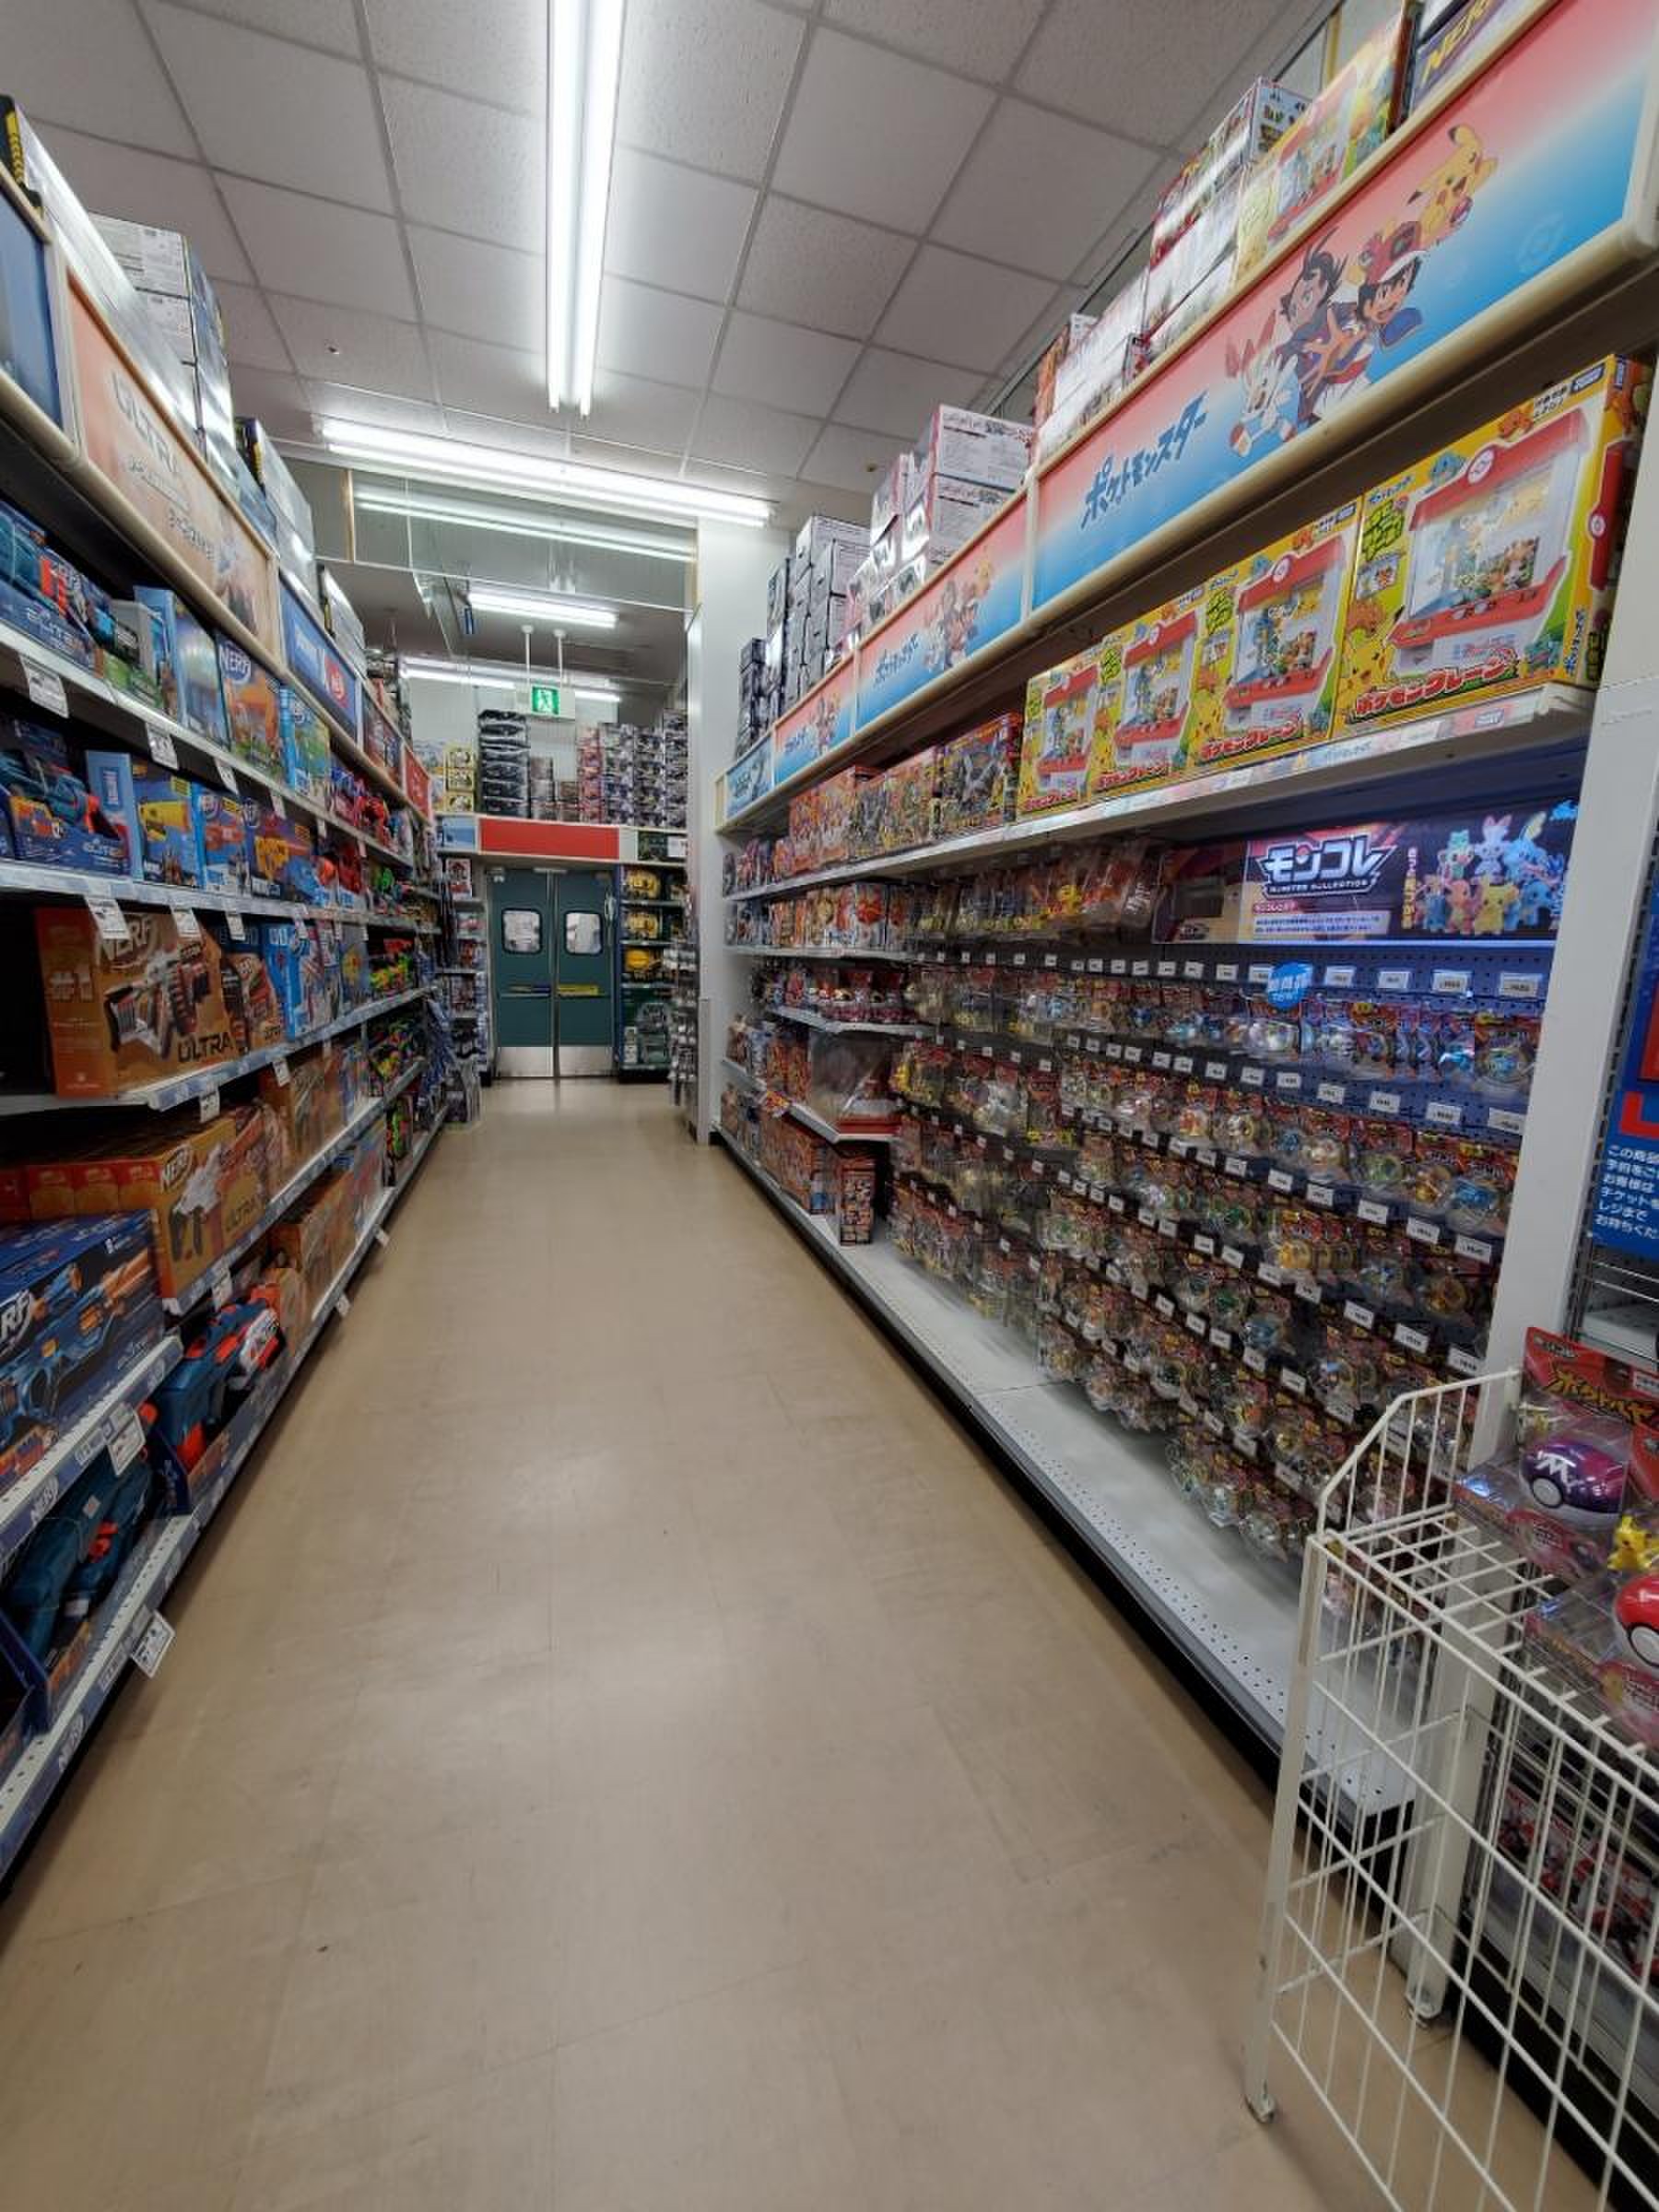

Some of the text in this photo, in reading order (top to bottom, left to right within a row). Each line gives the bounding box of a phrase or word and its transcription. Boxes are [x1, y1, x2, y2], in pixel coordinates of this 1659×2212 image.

[1264, 839, 1382, 883] モンコレ
[177, 1032, 234, 1063] ULTRA
